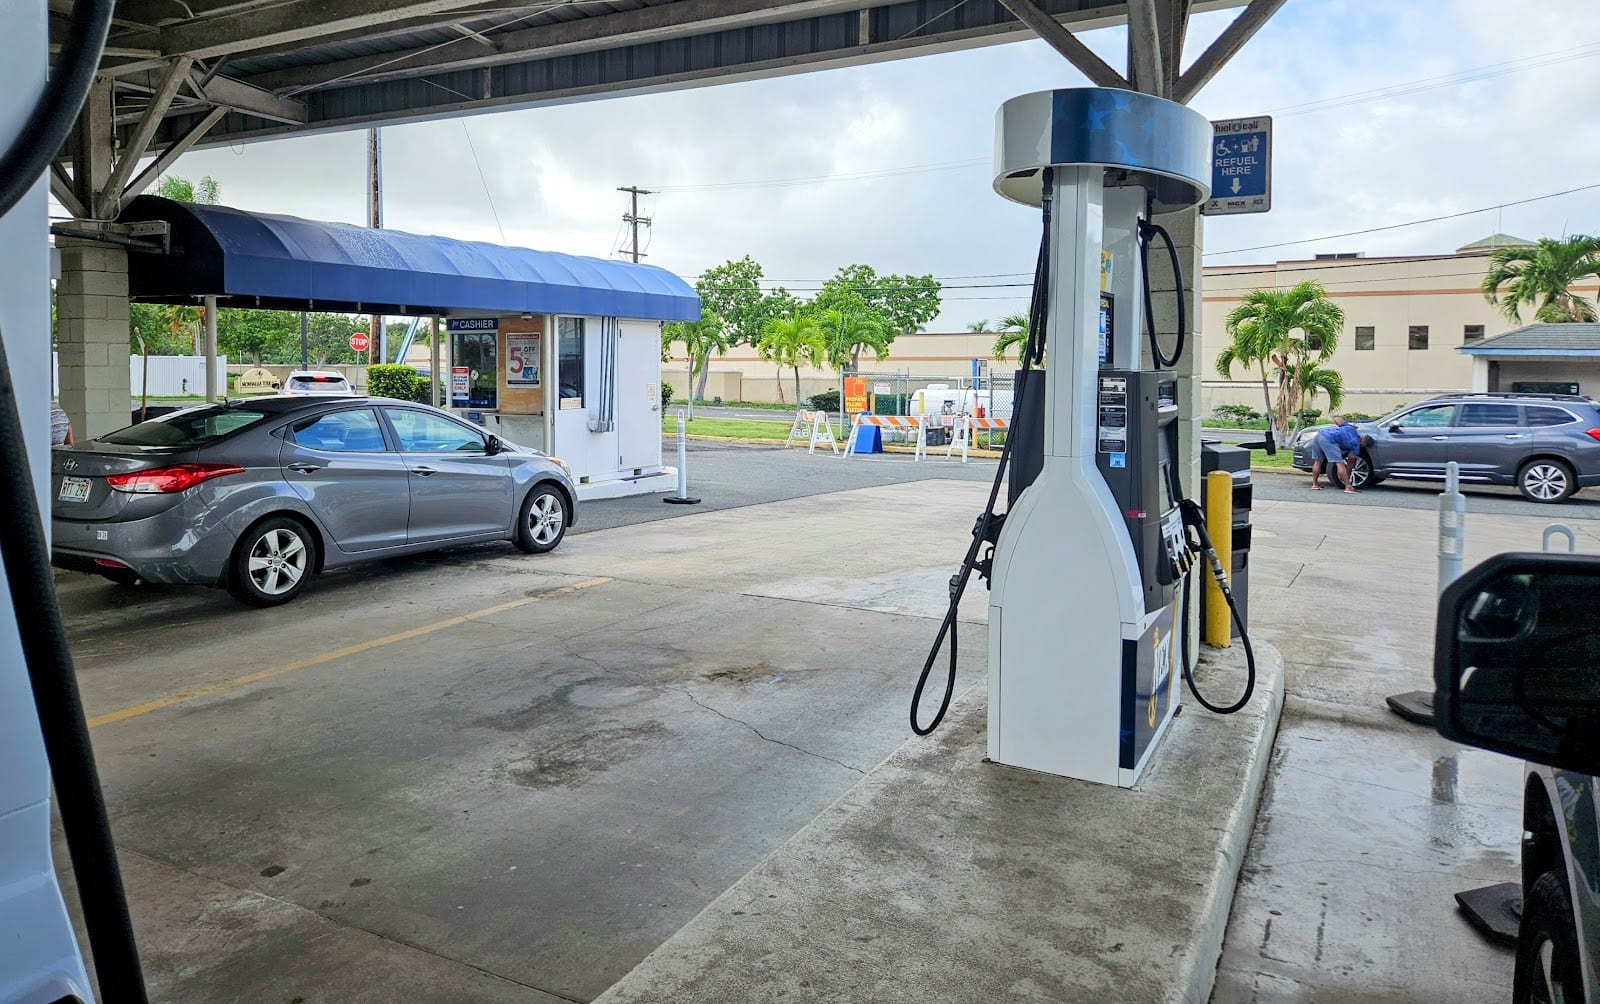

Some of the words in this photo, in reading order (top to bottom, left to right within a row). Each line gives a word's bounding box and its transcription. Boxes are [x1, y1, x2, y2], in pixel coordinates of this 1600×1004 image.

[1215, 123, 1231, 133] fuel
[1215, 156, 1258, 167] REFUEL
[1221, 166, 1251, 176] HERE
[459, 319, 494, 329] CASHIER
[350, 338, 368, 346] STOP
